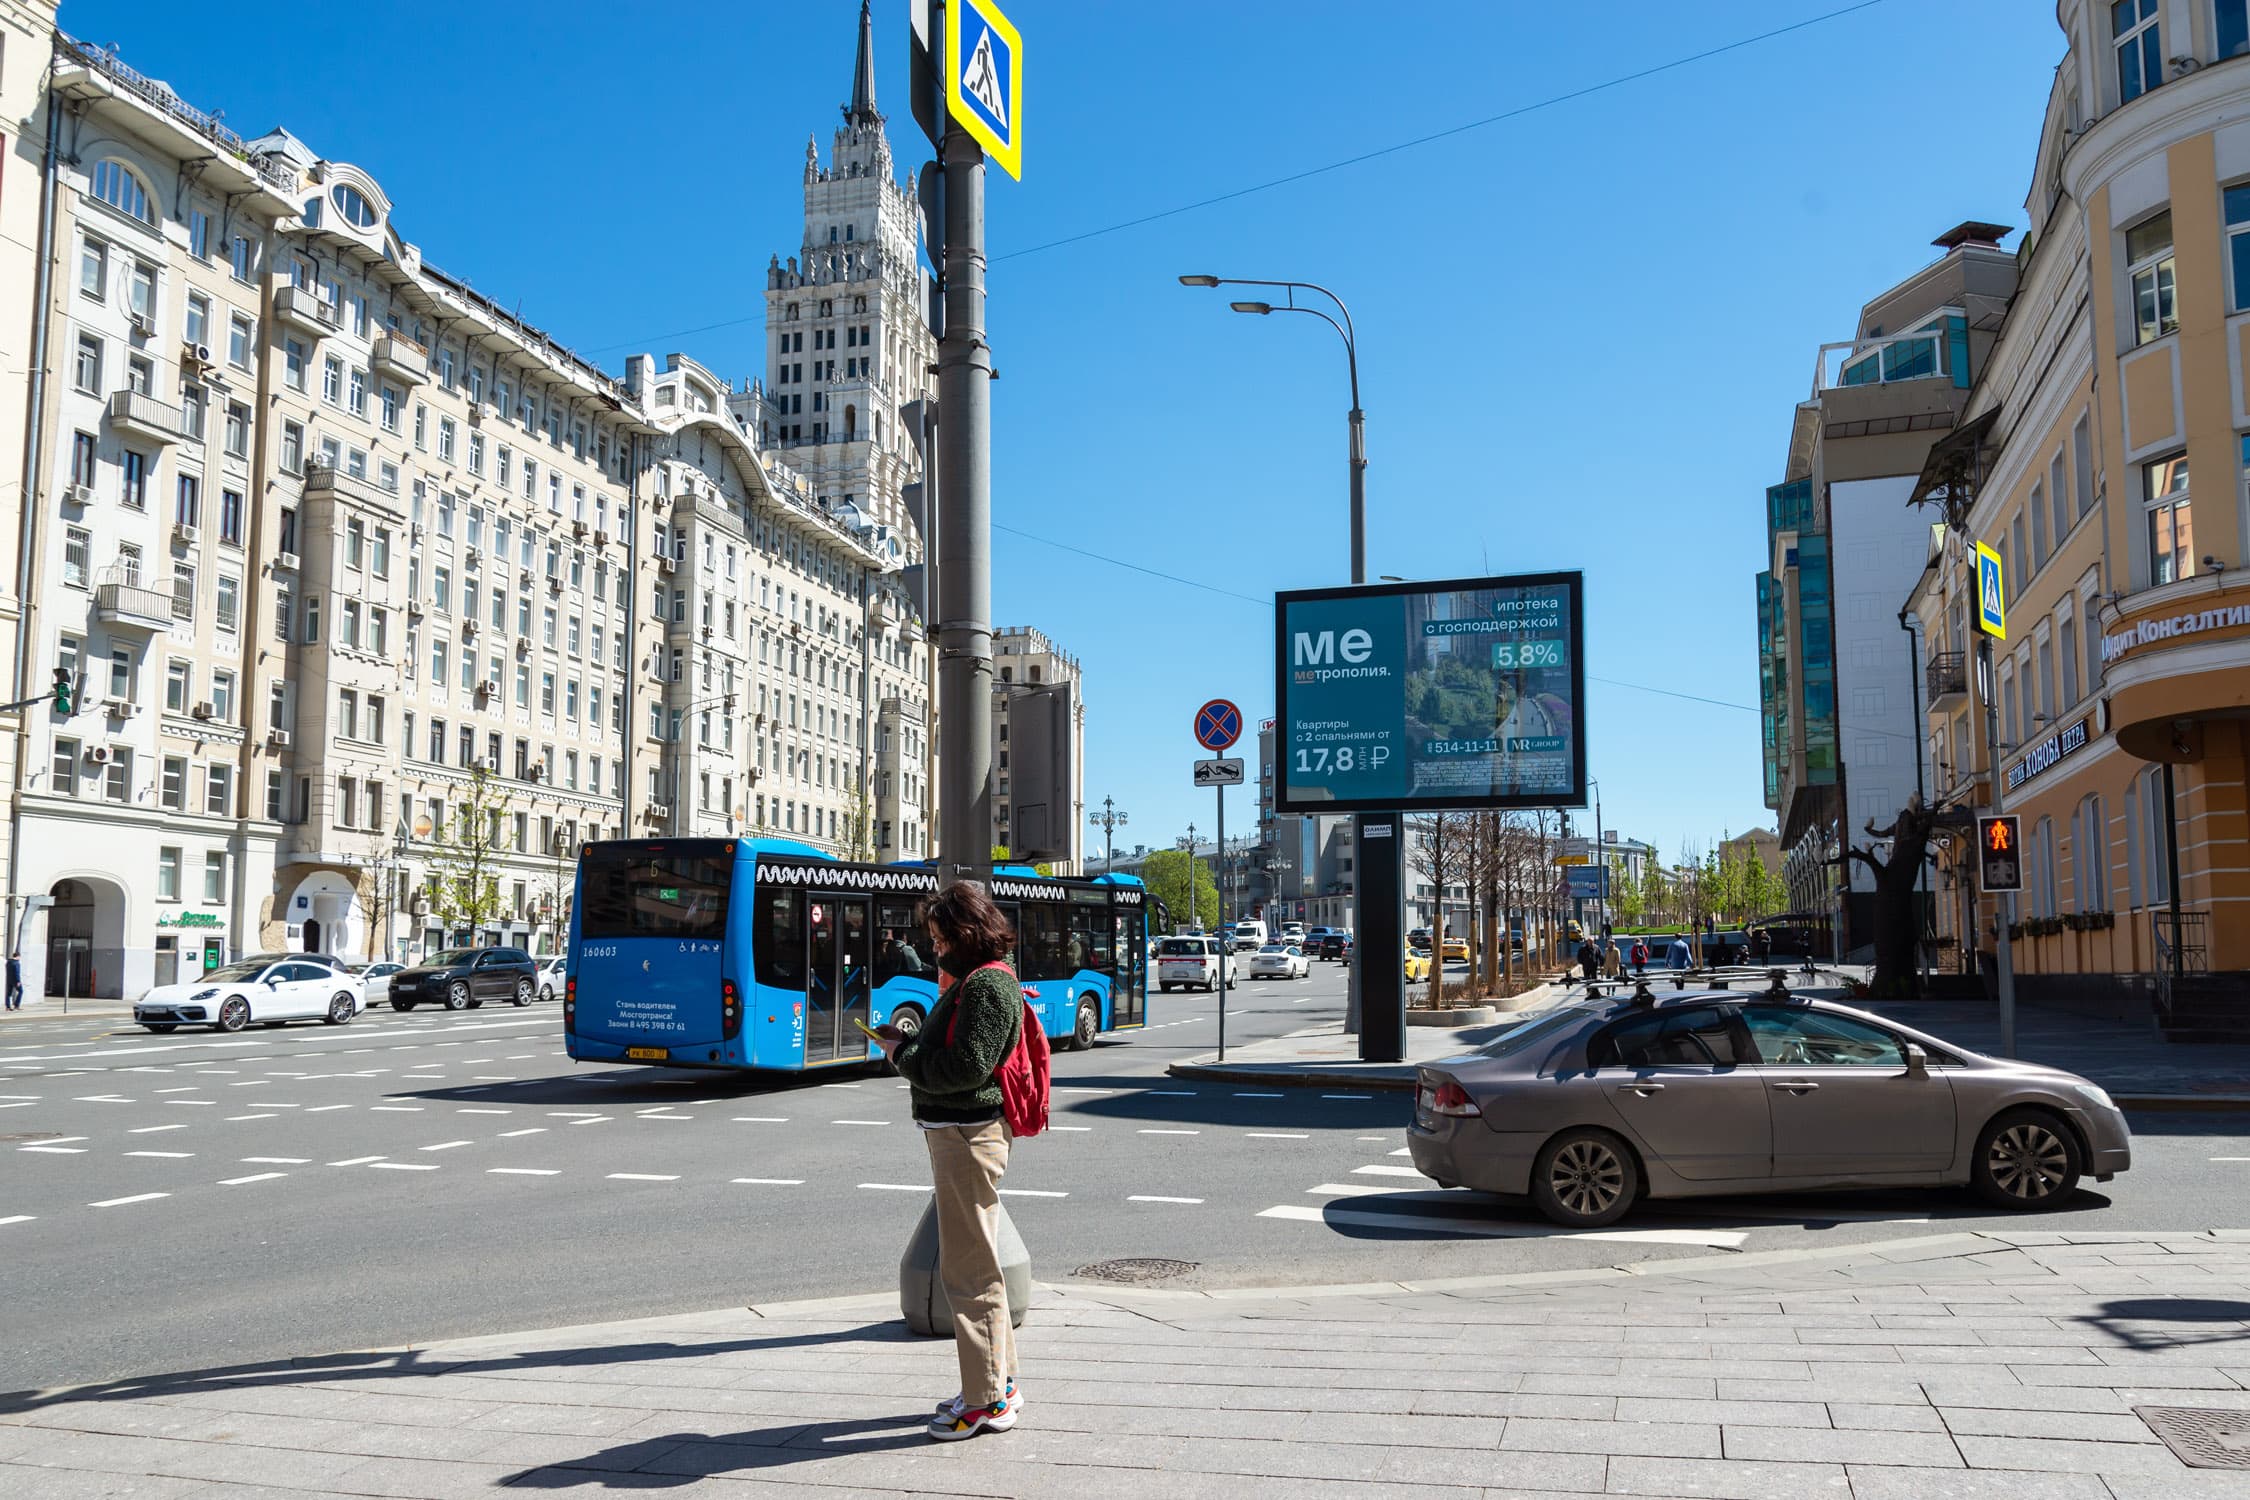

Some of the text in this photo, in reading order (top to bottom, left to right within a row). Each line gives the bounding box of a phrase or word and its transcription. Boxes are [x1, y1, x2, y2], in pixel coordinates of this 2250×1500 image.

[1497, 599, 1558, 611] ипотека
[1426, 614, 1558, 634] с господдержкой
[1497, 644, 1558, 668] 5,8%
[1295, 666, 1391, 683] метрополия.
[1296, 720, 1350, 731] Квартиры
[1296, 730, 1391, 742] с 2 спальнями от
[1435, 740, 1499, 753] 514-11-11
[1512, 739, 1530, 750] MR
[2025, 735, 2061, 779] КОНОБА
[2062, 723, 2086, 751] ПЕТРА
[1296, 747, 1354, 776] 17,8
[583, 946, 617, 957] 160603
[616, 1000, 676, 1010] Стань водителем
[619, 1011, 673, 1020] Мосгортранса!
[608, 1020, 629, 1028] Звони
[636, 1021, 650, 1029] 495
